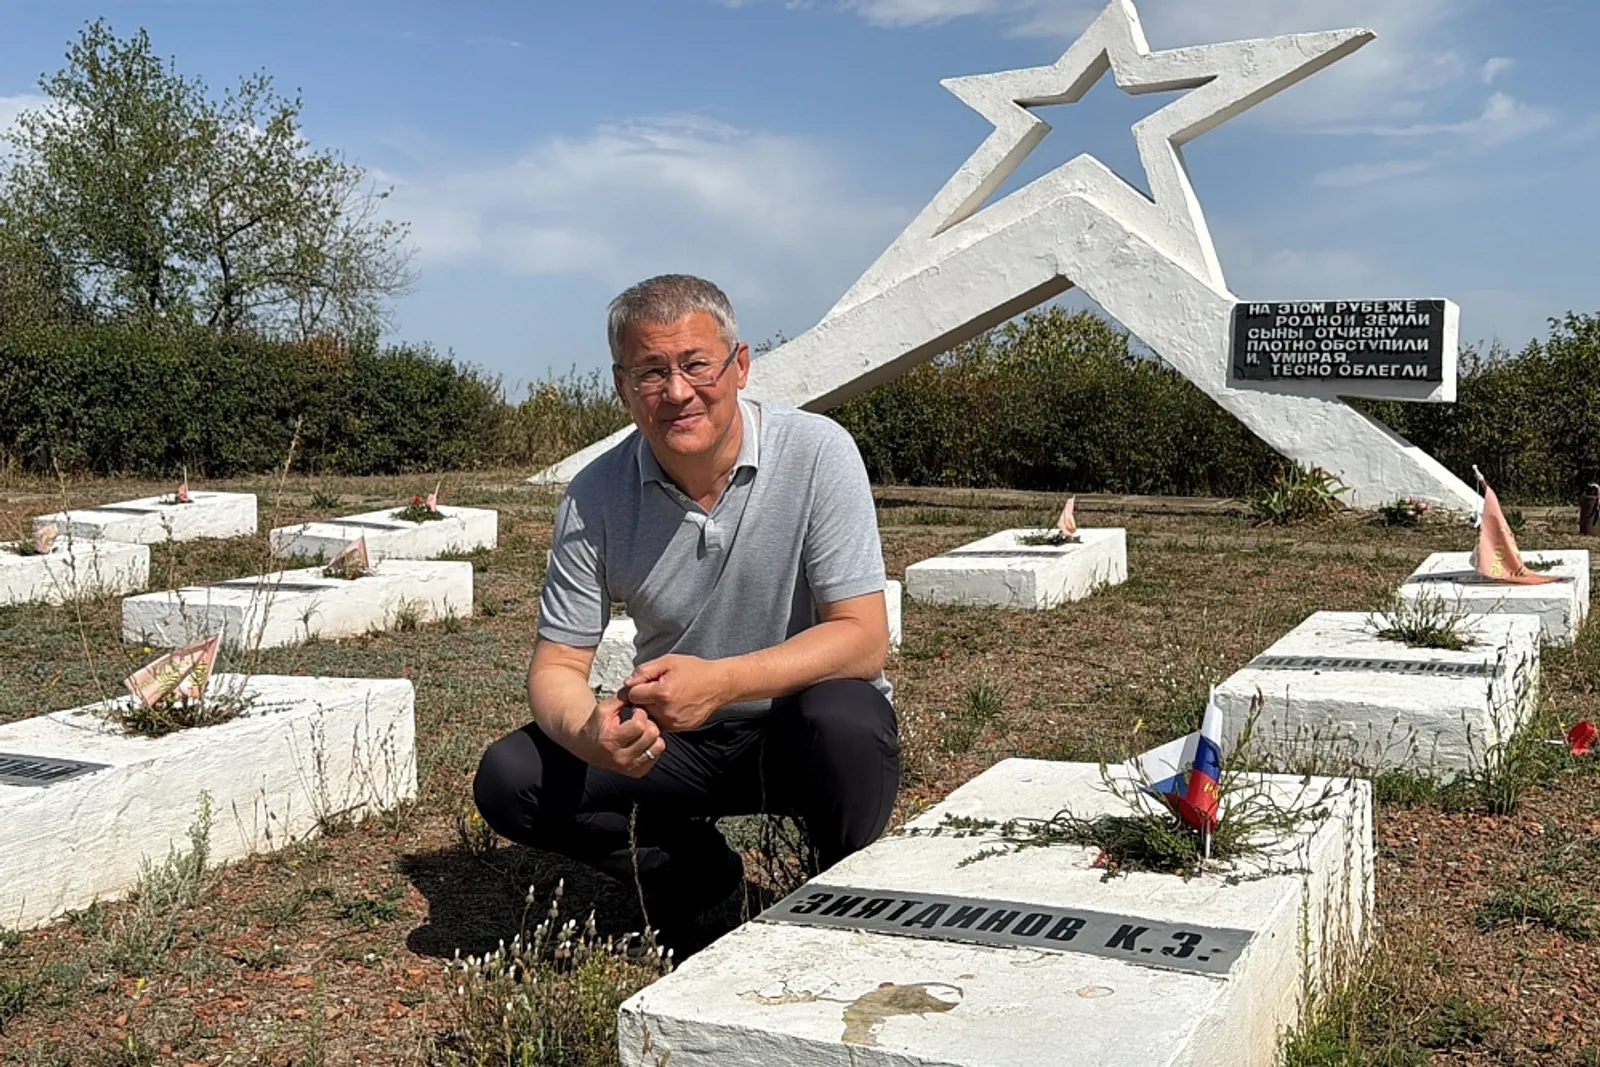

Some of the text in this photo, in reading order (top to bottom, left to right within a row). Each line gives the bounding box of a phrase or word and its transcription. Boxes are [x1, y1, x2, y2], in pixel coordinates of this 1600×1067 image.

[1249, 304, 1271, 315] НА
[1336, 301, 1417, 313] РУБЕЖЕ
[1364, 314, 1430, 326] ЗЕМЛИ
[1248, 327, 1398, 339] СЫНЫ ОТЧИЗНУ
[1247, 339, 1429, 351] ПЛОТНО ОБСТУПИЛИ
[1272, 365, 1428, 377] ТЕСНО ОБЛЕГЛИ
[789, 892, 1087, 942] ЗИЯТДИНОВ
